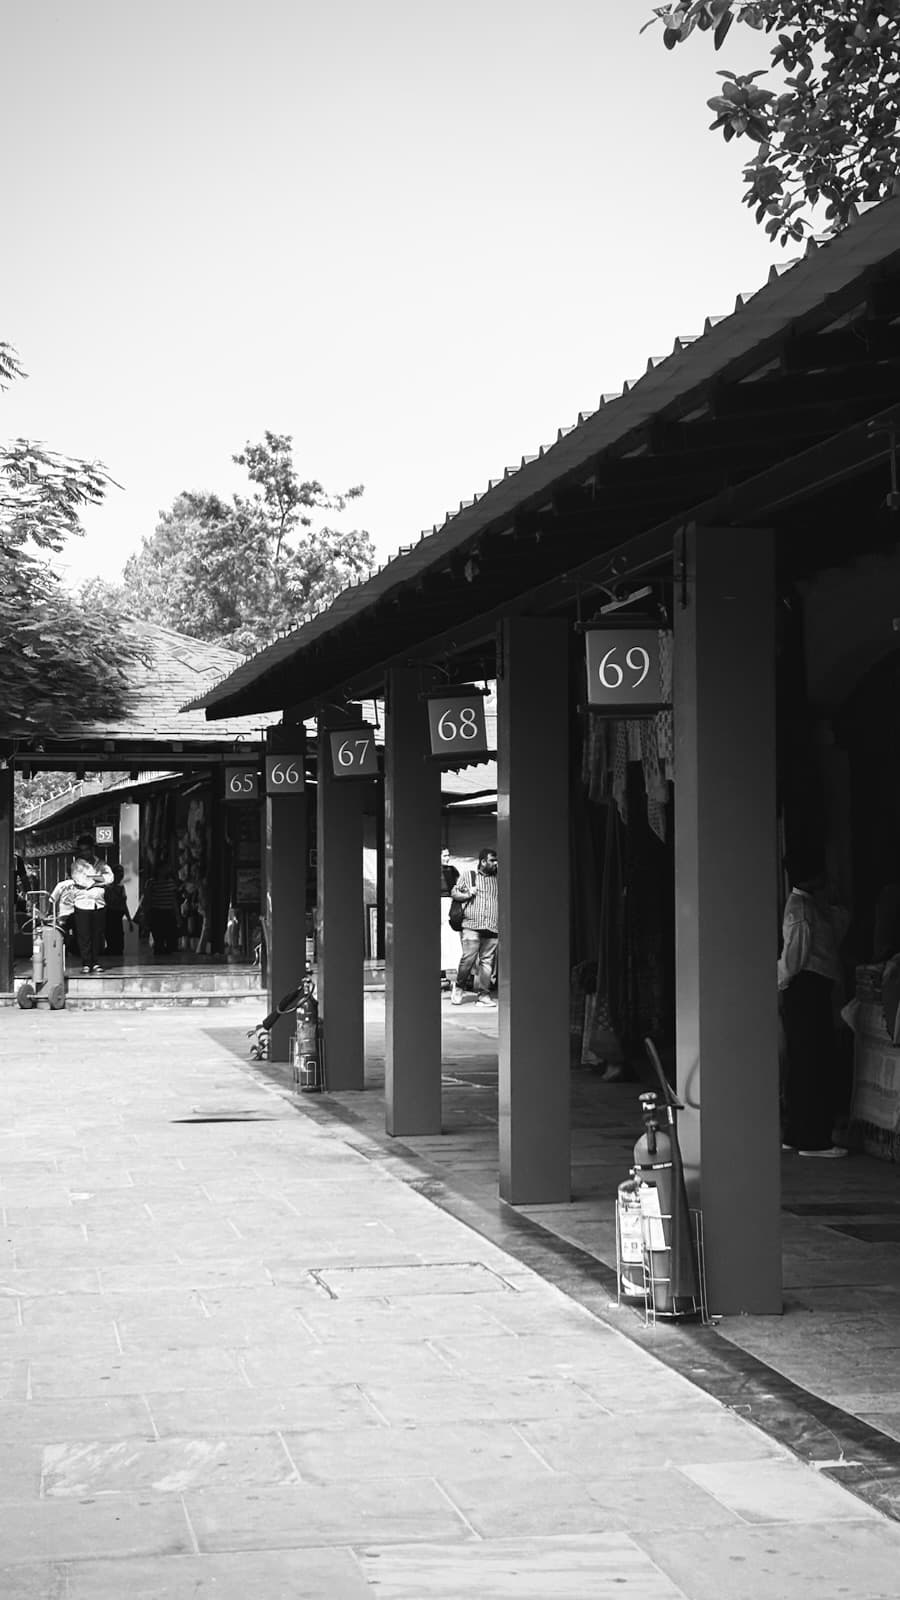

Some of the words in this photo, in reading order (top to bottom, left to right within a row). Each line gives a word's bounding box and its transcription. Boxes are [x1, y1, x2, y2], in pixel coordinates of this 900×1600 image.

[599, 646, 650, 688] 69
[437, 707, 478, 741] 68
[338, 739, 370, 767] 67
[230, 773, 254, 793] 65
[271, 762, 299, 785] 66
[98, 829, 112, 841] 59
